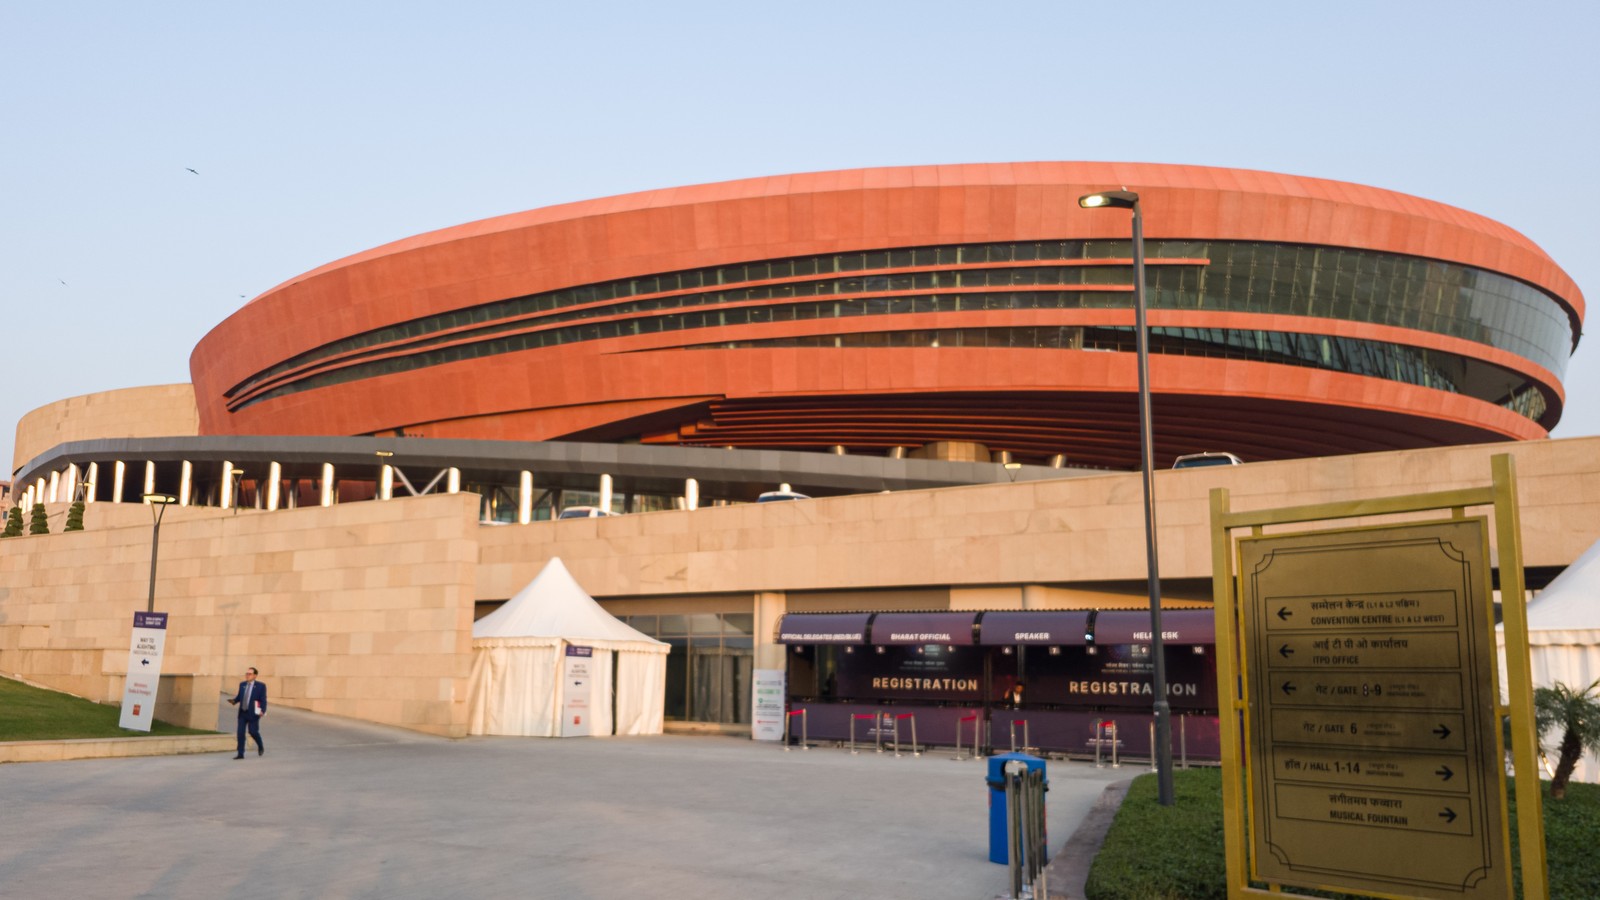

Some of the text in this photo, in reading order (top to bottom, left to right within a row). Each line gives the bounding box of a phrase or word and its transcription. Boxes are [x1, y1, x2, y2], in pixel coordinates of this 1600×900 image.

[1311, 616, 1359, 625] CONVENTION
[1362, 615, 1393, 624] CENTRE
[1015, 632, 1050, 640] SPEAKER
[1161, 631, 1179, 640] ESK
[1312, 637, 1408, 650] आई टी पी ओ कार्यालय
[1313, 655, 1359, 664] ITPO OFFICE
[873, 677, 978, 691] REGISTRATION
[1069, 681, 1196, 696] REGISTRAION
[1337, 686, 1357, 695] GATE
[1324, 724, 1344, 733] GATE
[1350, 722, 1358, 734] 6
[1310, 762, 1330, 771] HALL
[1334, 761, 1360, 774] 1-14
[1330, 810, 1408, 825] MUSICAL FOUNTAIN
